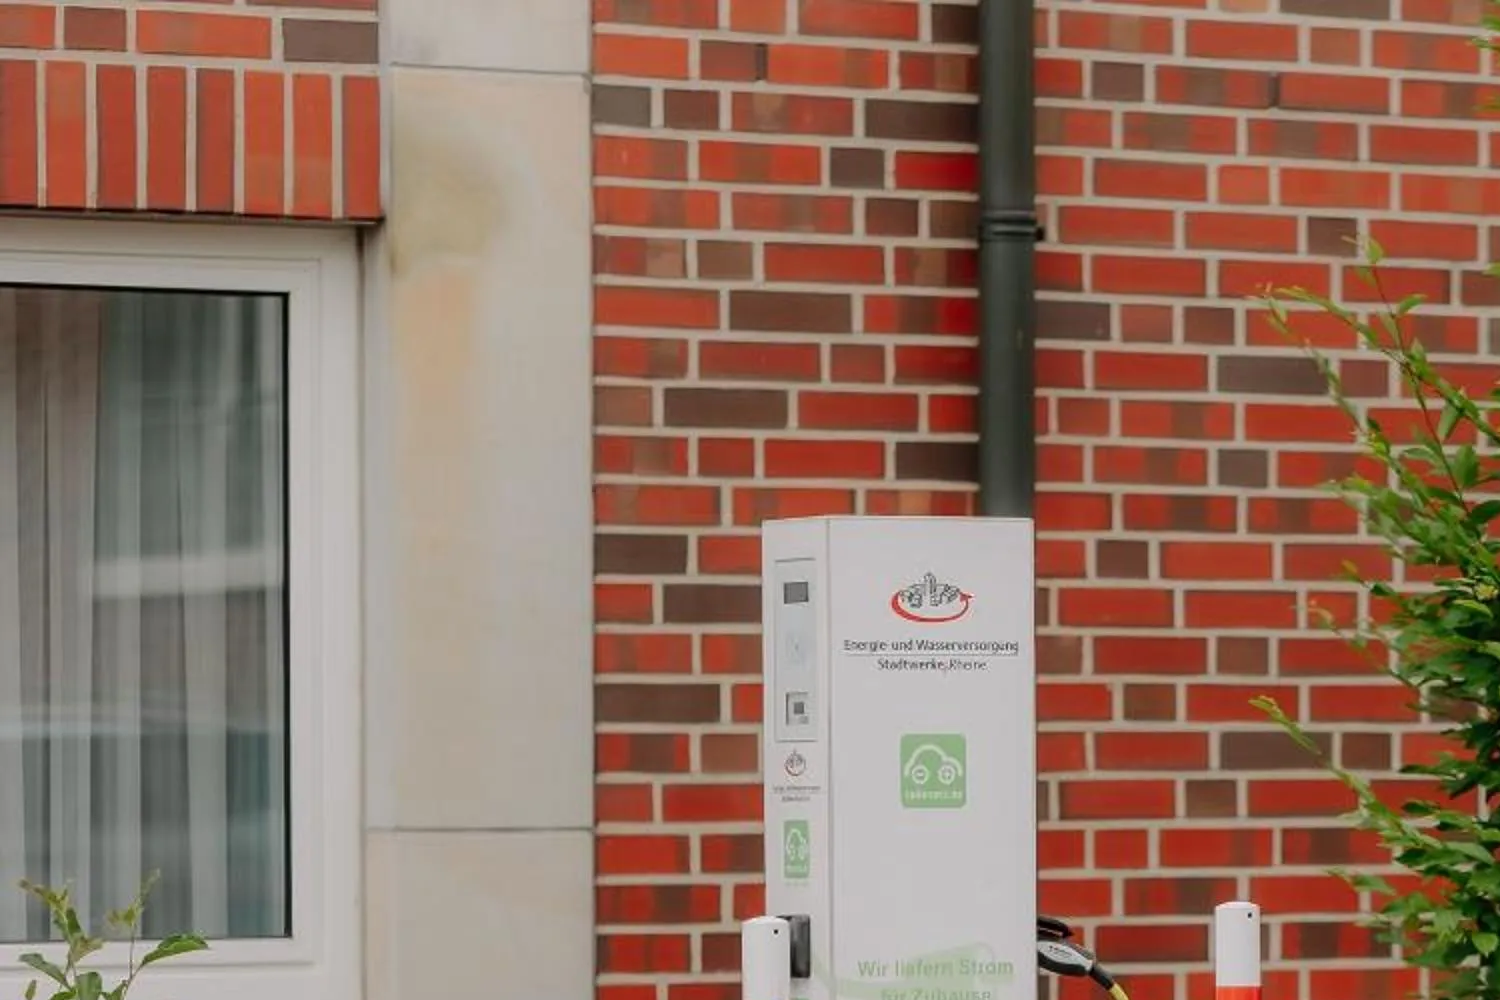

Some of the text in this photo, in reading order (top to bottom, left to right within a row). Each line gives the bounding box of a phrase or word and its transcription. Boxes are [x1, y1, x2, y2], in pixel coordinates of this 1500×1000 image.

[891, 639, 913, 651] und
[915, 639, 1019, 654] Wasserversorgung
[877, 658, 944, 671] Stadtwerke
[858, 958, 1015, 977] Wir liefern Strom
